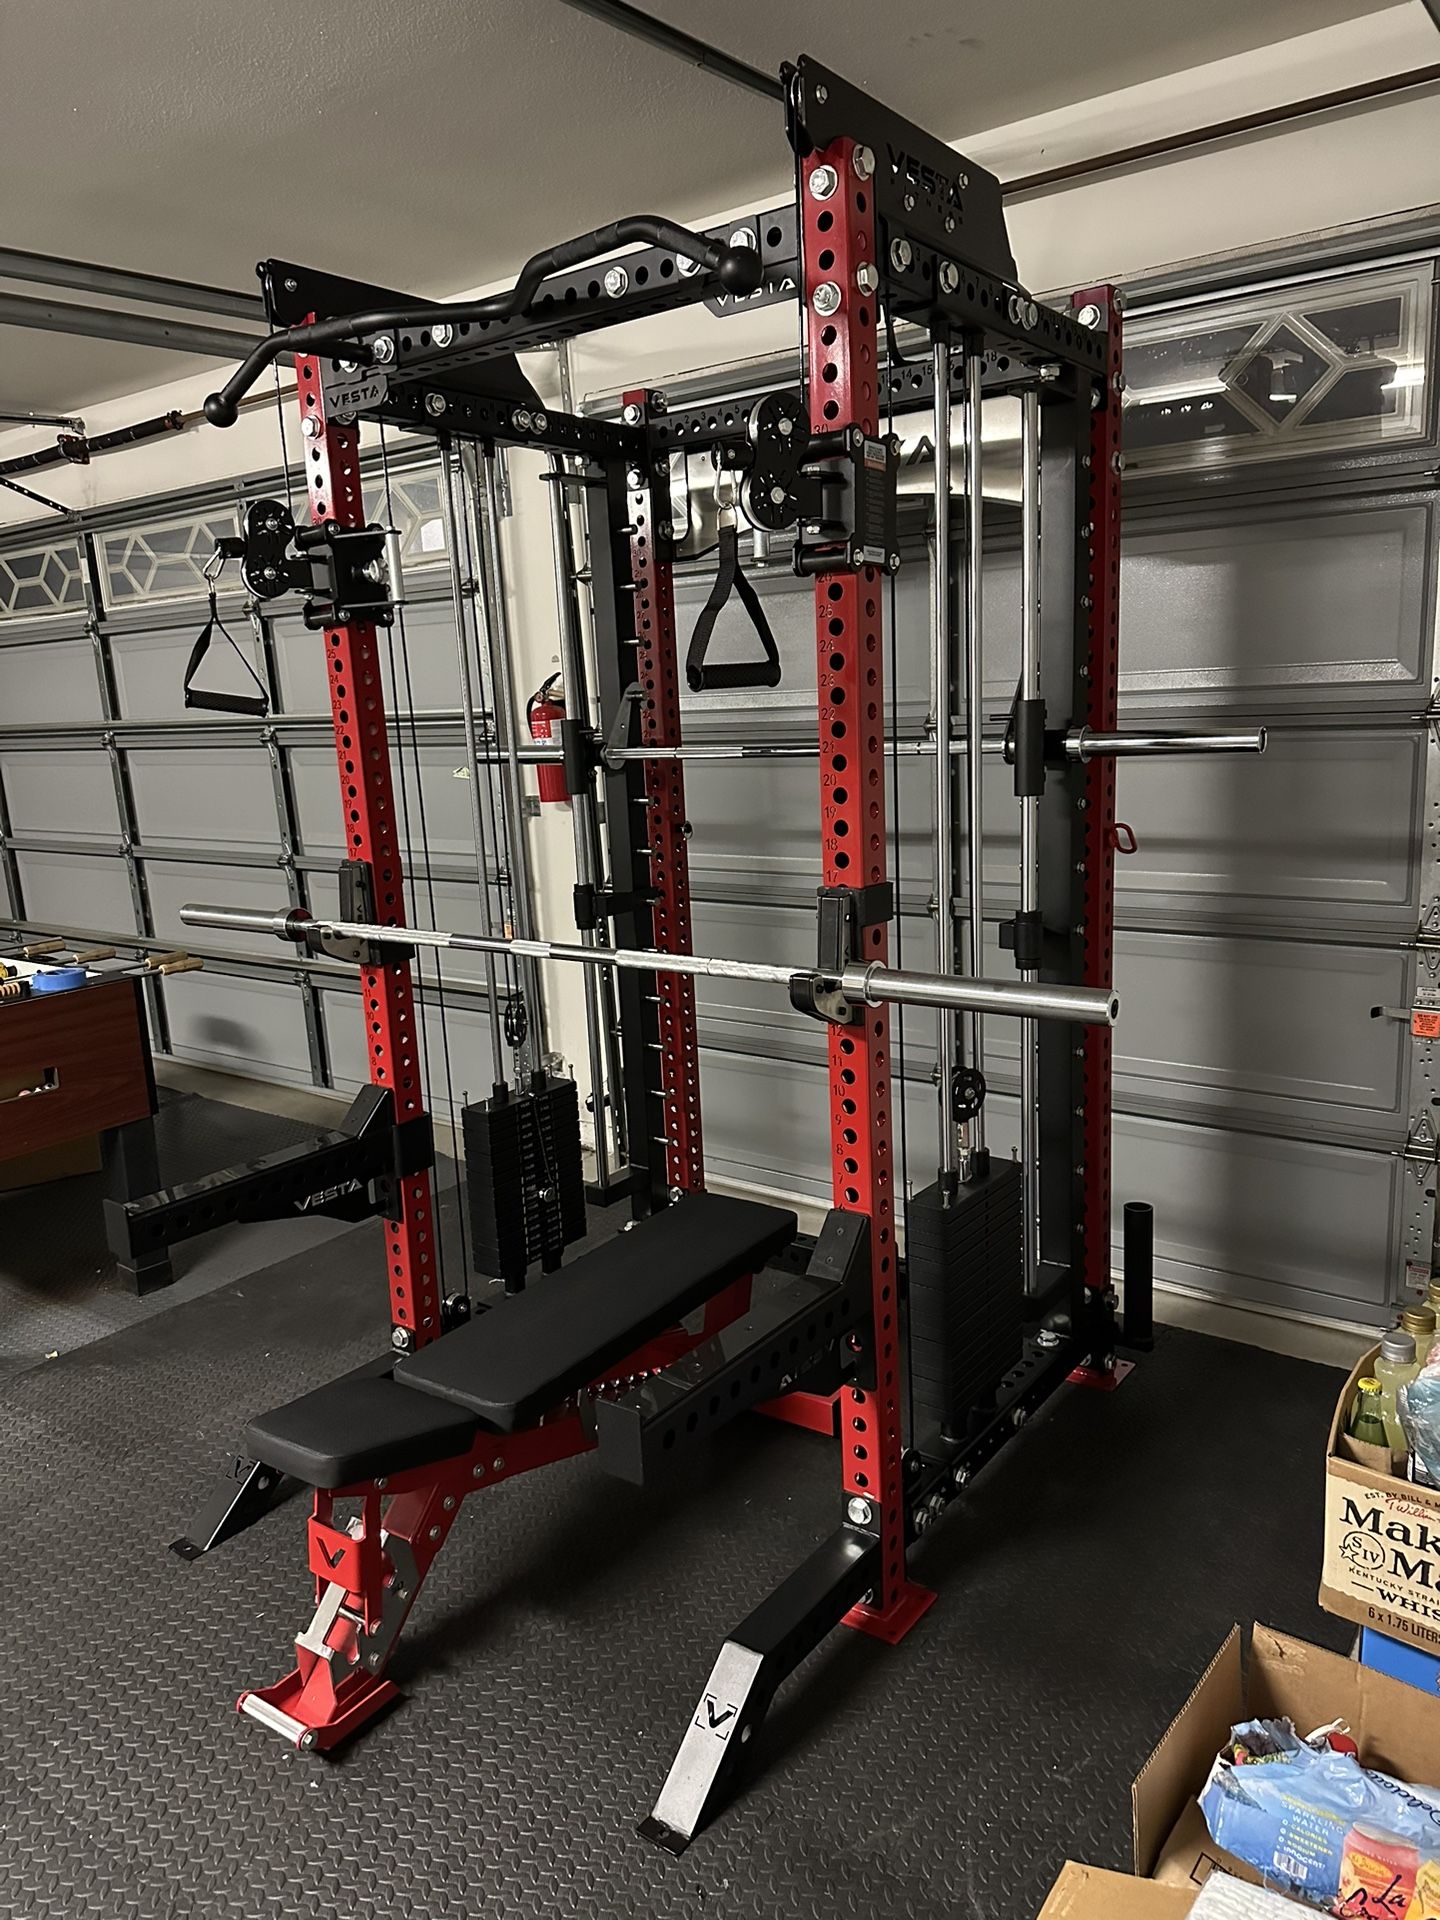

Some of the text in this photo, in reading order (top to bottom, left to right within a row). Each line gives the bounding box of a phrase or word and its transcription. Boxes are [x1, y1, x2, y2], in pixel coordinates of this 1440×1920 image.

[886, 142, 964, 212] VESTA
[901, 369, 912, 380] 14
[923, 365, 933, 375] 15
[986, 351, 997, 362] 18
[329, 385, 379, 408] VESTA
[818, 604, 833, 618] 25
[819, 640, 834, 652] 24
[820, 674, 835, 686] 23
[332, 700, 342, 710] 23
[821, 708, 836, 720] 22
[336, 726, 345, 735] 22
[822, 741, 835, 754] 21
[338, 751, 347, 760] 21
[341, 775, 350, 785] 20
[823, 774, 837, 786] 20
[344, 800, 352, 809] 19
[824, 806, 837, 819] 19
[347, 824, 355, 833] 18
[825, 838, 838, 851] 18
[349, 848, 357, 857] 17
[826, 870, 839, 882] 17
[364, 989, 371, 997] 11
[366, 1012, 375, 1021] 10
[831, 1025, 843, 1037] 12
[369, 1034, 374, 1043] 9
[371, 1057, 377, 1066] 8
[832, 1054, 843, 1067] 11
[833, 1084, 846, 1097] 10
[835, 1114, 842, 1125] 9
[836, 1143, 844, 1155] 8
[838, 1173, 843, 1184] 7
[294, 1177, 363, 1211] VESTA
[1339, 1497, 1440, 1557] Mak
[1352, 1536, 1362, 1549] S
[316, 1536, 346, 1569] V
[1362, 1548, 1380, 1563] IV
[1387, 1548, 1440, 1594] M
[1348, 1567, 1404, 1591] KENTUCKY
[1368, 1607, 1440, 1644] 6 x 1.75 LITER
[1280, 1801, 1344, 1835] SPARKLING
[1292, 1814, 1329, 1836] WATER
